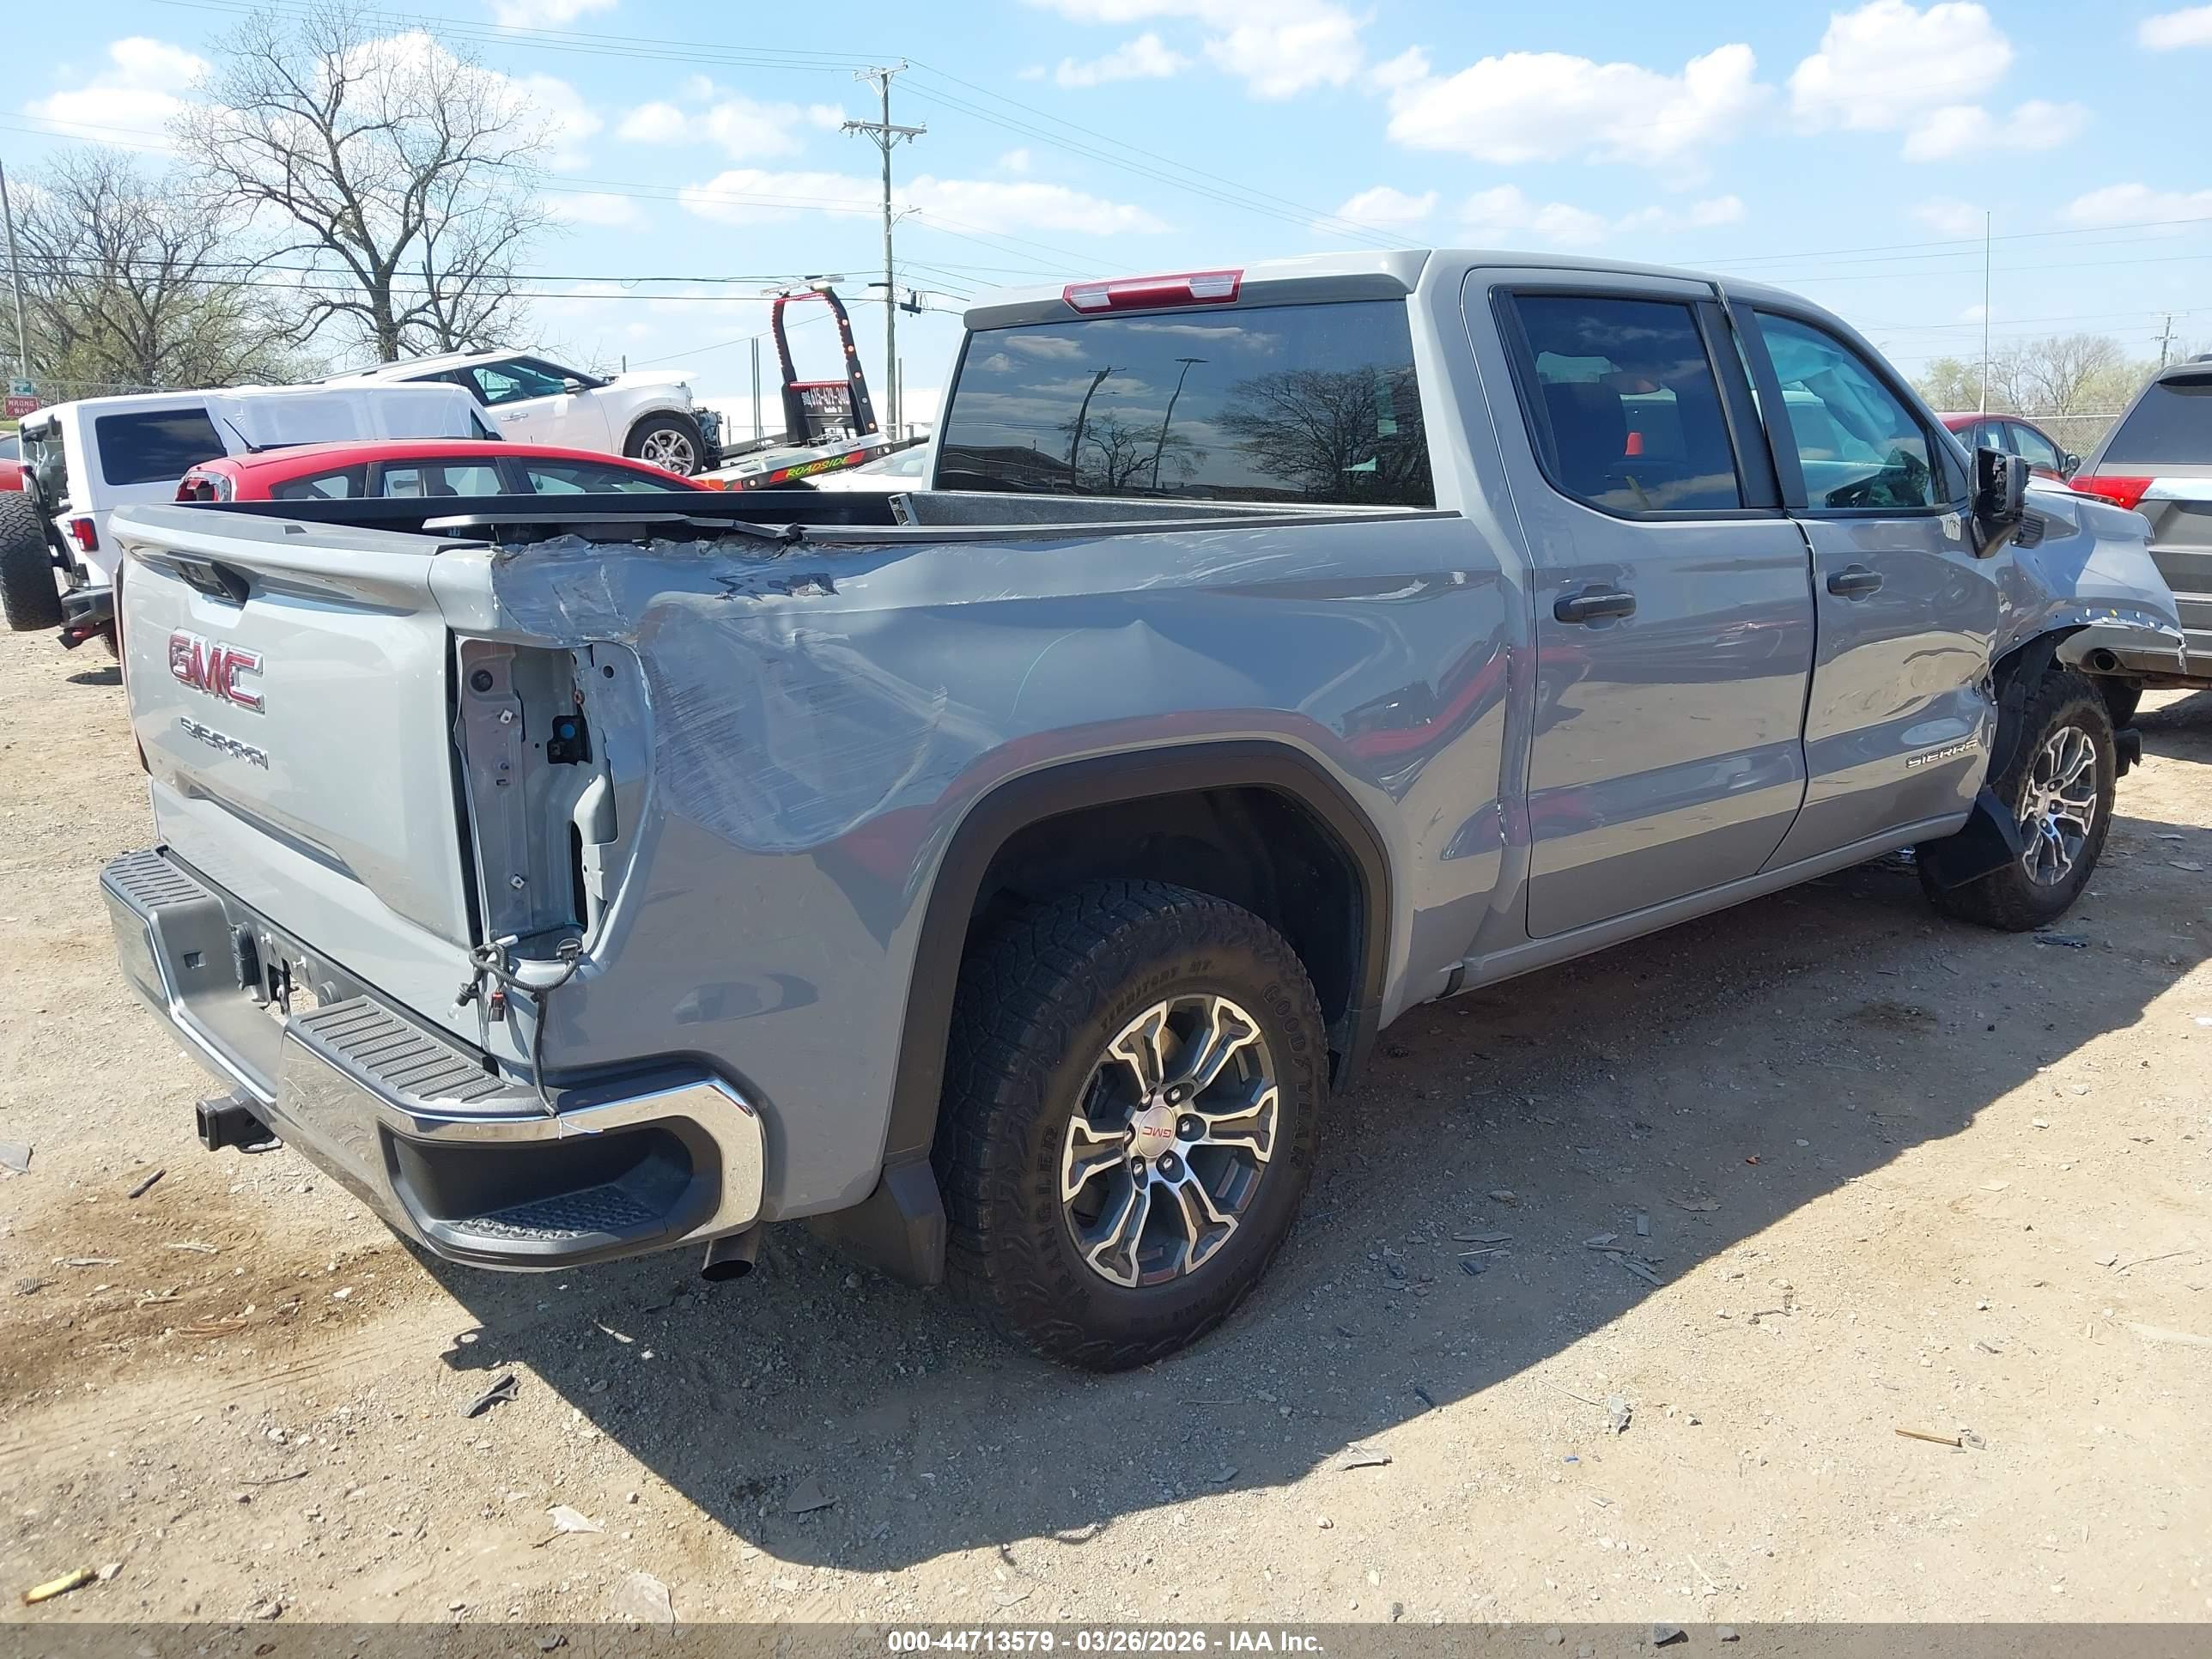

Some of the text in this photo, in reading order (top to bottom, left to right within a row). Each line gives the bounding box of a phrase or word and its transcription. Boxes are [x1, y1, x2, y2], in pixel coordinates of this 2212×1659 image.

[786, 455, 850, 478] ROADSIDE
[168, 627, 267, 718] GMC
[180, 715, 269, 770] SIERRA
[1905, 738, 1979, 769] SIERRA
[1142, 1126, 1172, 1139] GMC
